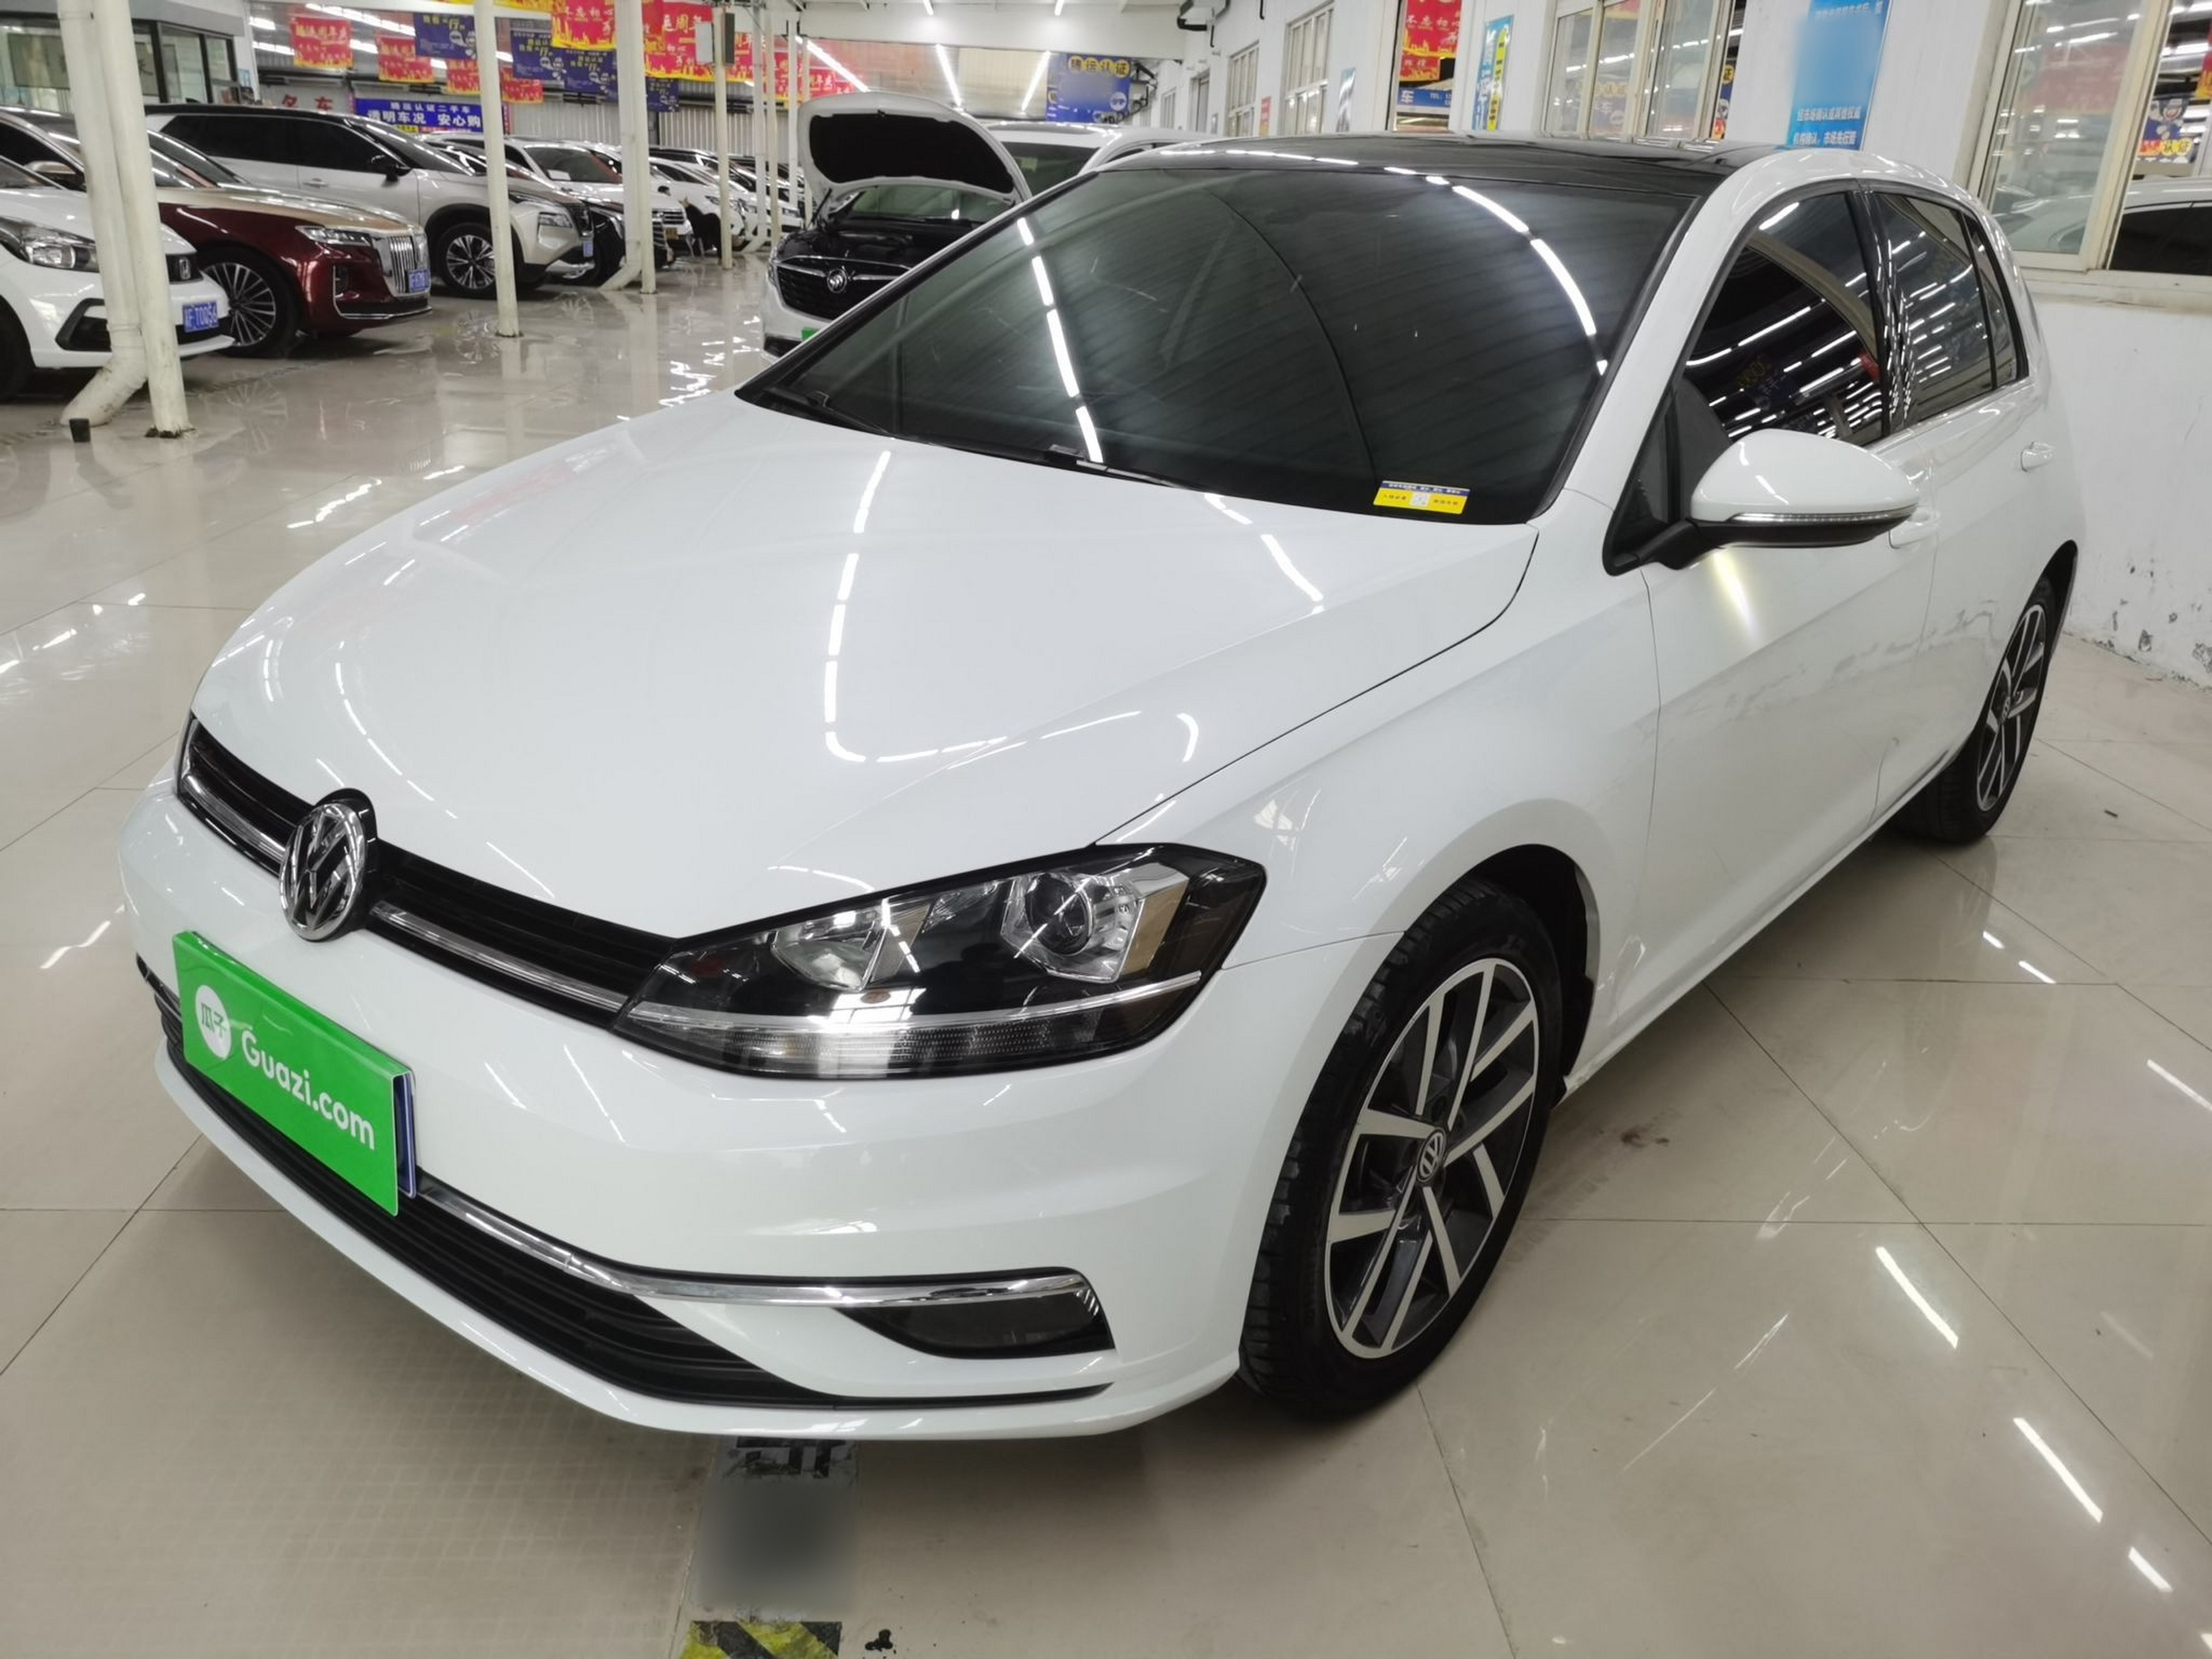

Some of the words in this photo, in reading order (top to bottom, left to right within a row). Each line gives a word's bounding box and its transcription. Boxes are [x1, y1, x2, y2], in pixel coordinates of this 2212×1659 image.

[1400, 90, 1414, 104] 车
[437, 113, 481, 127] 安心购
[201, 1002, 226, 1037] 瓜子
[242, 1030, 374, 1150] Guazi.com
